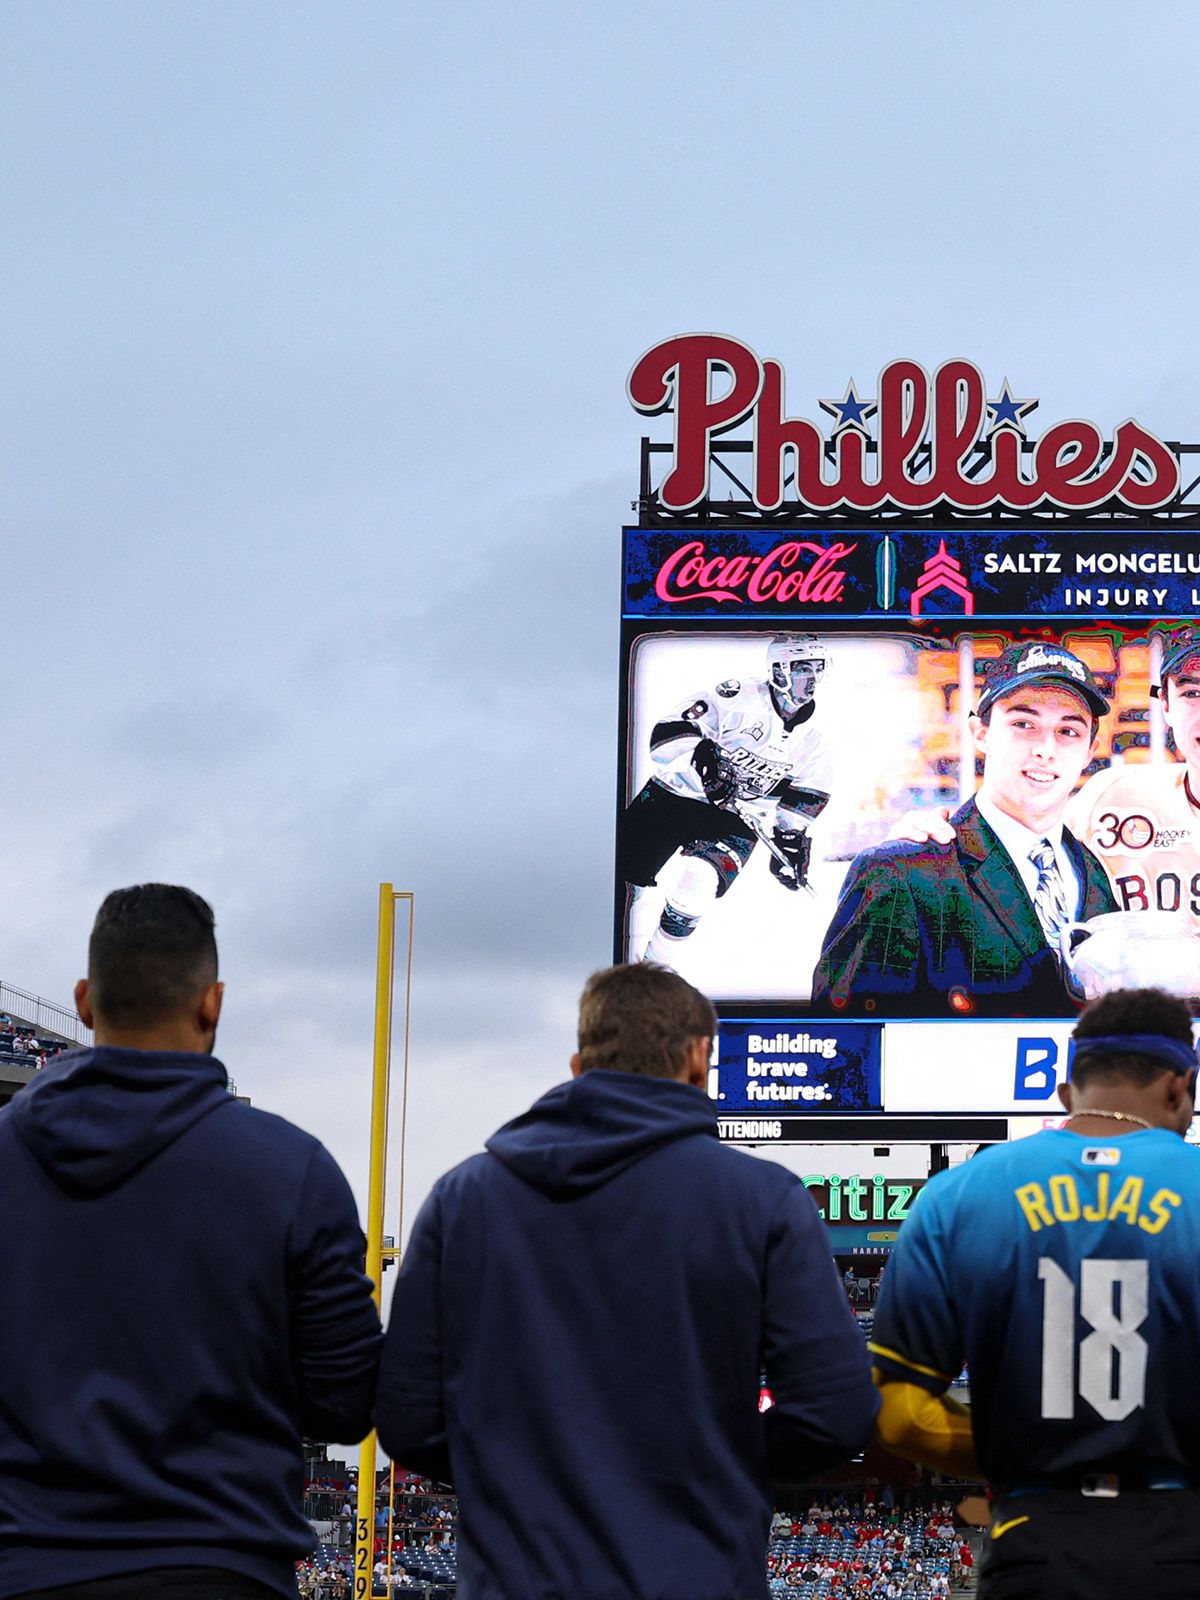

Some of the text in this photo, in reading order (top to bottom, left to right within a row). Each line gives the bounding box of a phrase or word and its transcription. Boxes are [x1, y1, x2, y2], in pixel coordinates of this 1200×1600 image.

[627, 332, 1181, 511] Phillies
[655, 541, 857, 602] Coca-Cola
[984, 553, 1062, 574] SALTZ
[1065, 588, 1168, 606] INJURY
[1097, 812, 1155, 849] 30
[1153, 839, 1176, 848] EAST
[748, 1034, 837, 1059] Building
[747, 1057, 808, 1077] brave
[1015, 1172, 1181, 1235] ROJAS
[1038, 1257, 1149, 1421] 18
